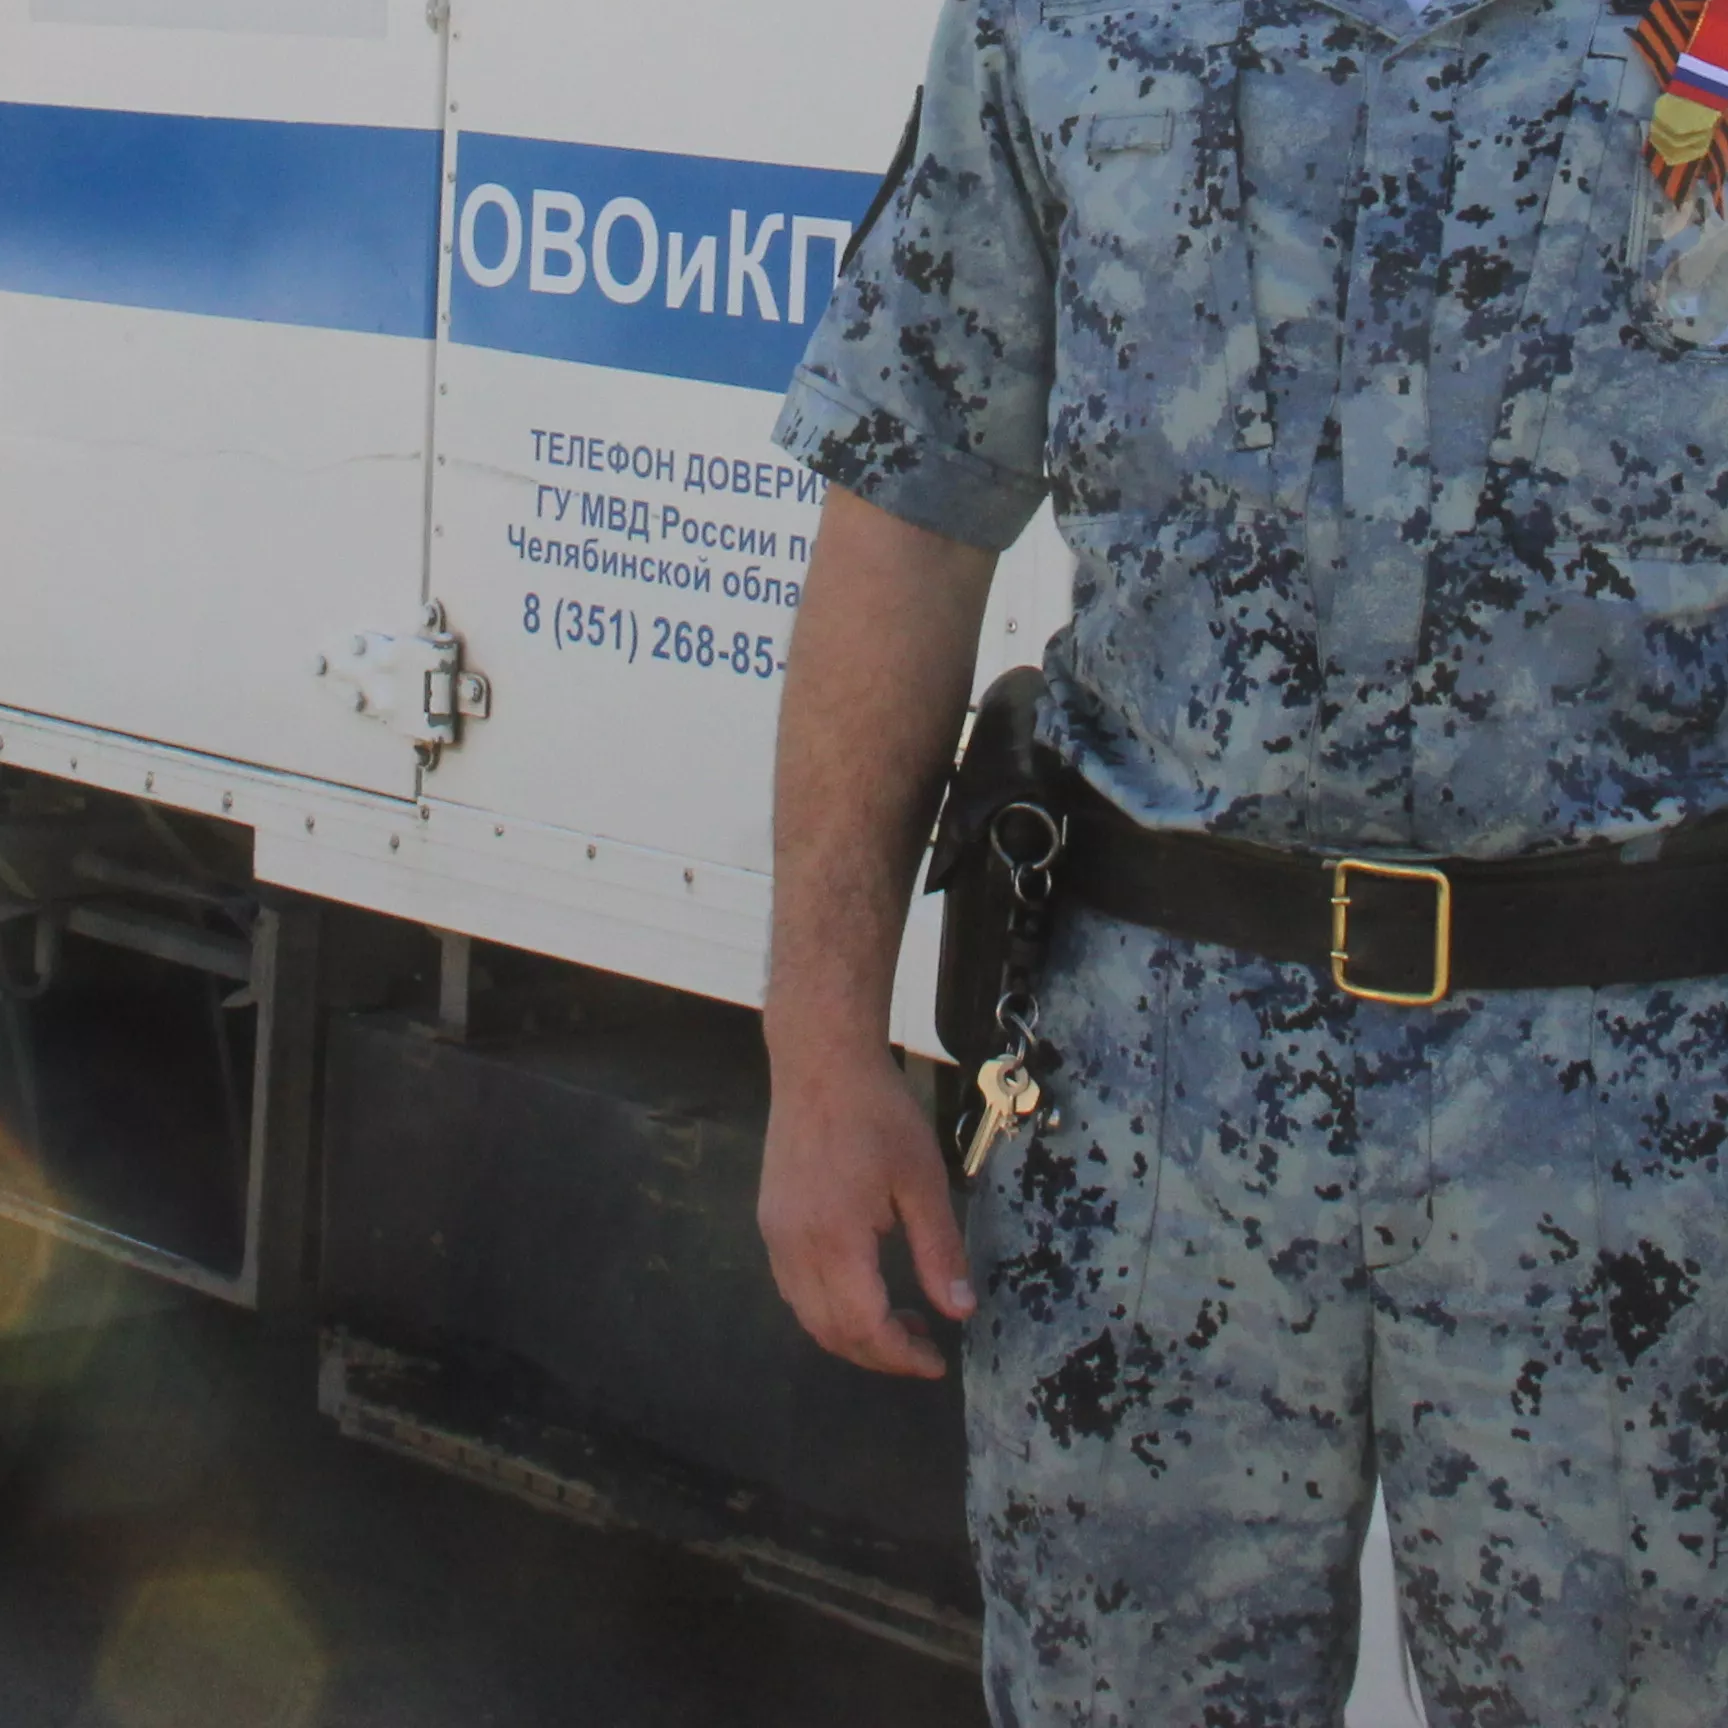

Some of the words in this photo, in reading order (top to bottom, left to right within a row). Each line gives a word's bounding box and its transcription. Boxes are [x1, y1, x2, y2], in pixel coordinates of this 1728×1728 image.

[530, 429, 675, 483] ТЕЛЕФОН
[507, 524, 711, 593] Челябинской
[536, 484, 573, 524] ГУ
[581, 493, 651, 544] МВД
[660, 503, 777, 558] России
[788, 534, 815, 564] п
[522, 592, 540, 634] 8
[553, 598, 640, 665] (351)
